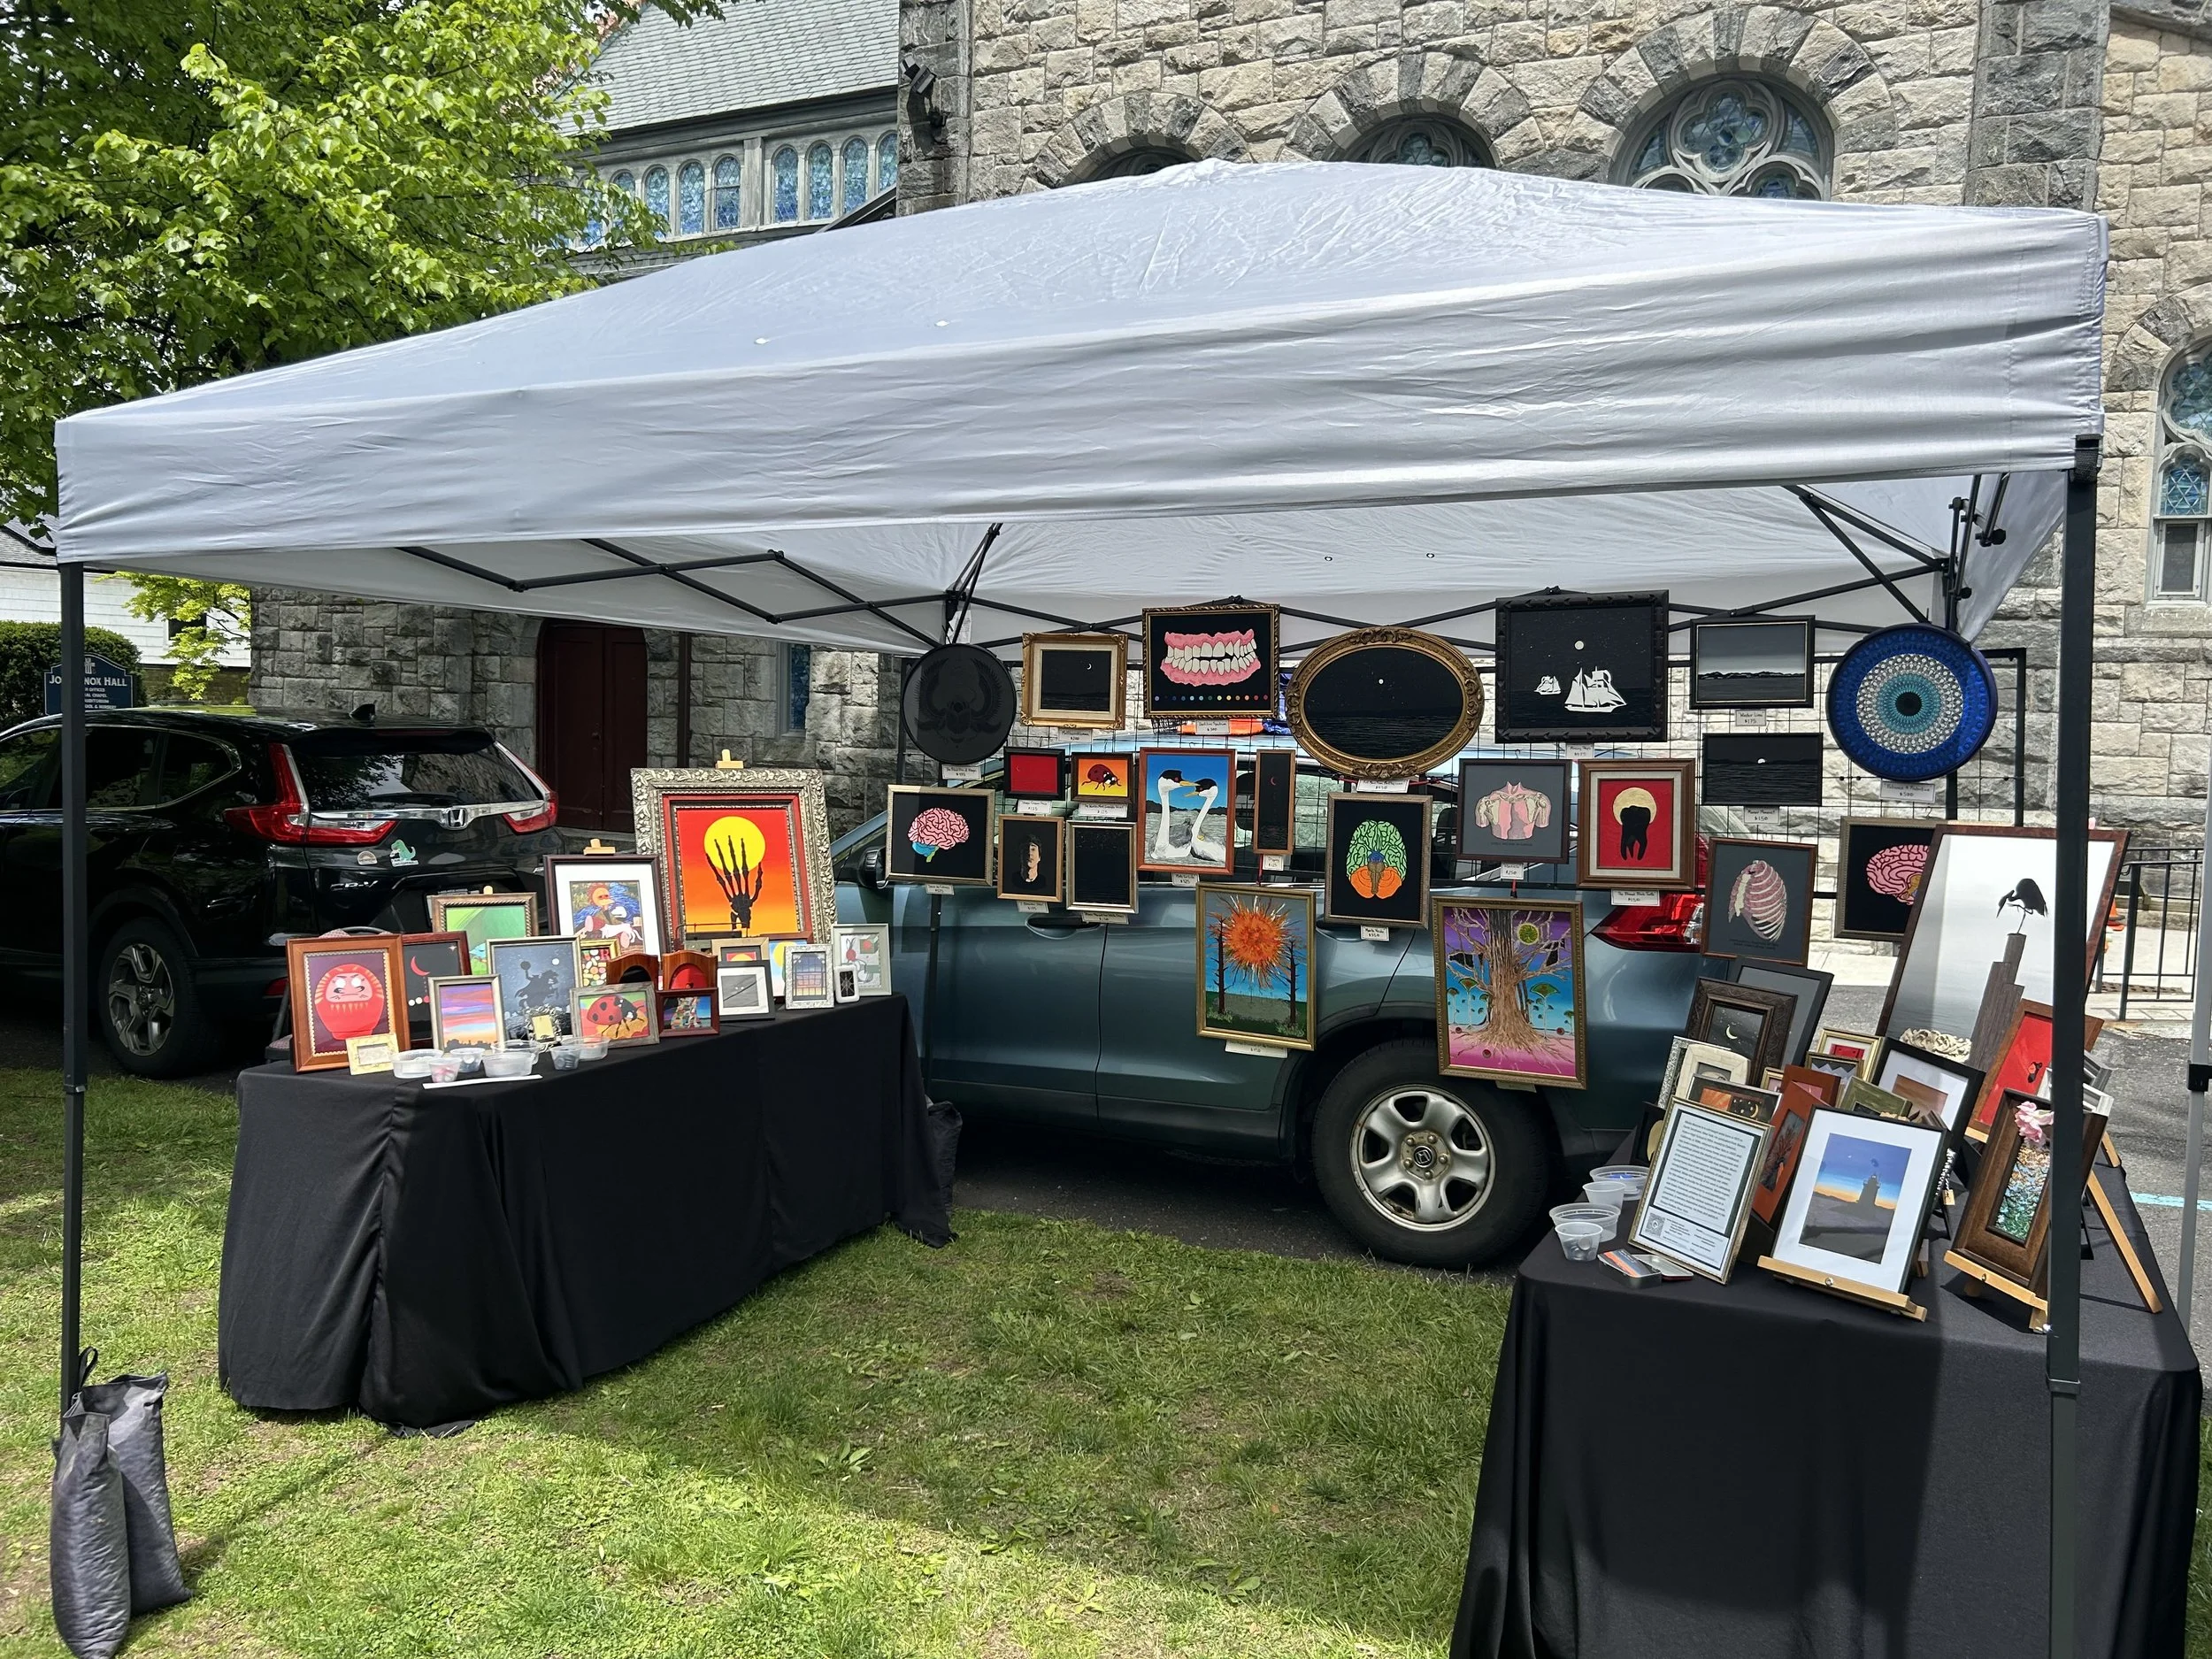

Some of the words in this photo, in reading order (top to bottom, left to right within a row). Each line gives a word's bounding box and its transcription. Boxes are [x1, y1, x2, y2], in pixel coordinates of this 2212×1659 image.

[49, 675, 62, 684] JO
[84, 677, 102, 686] NOX
[104, 677, 127, 687] HALL
